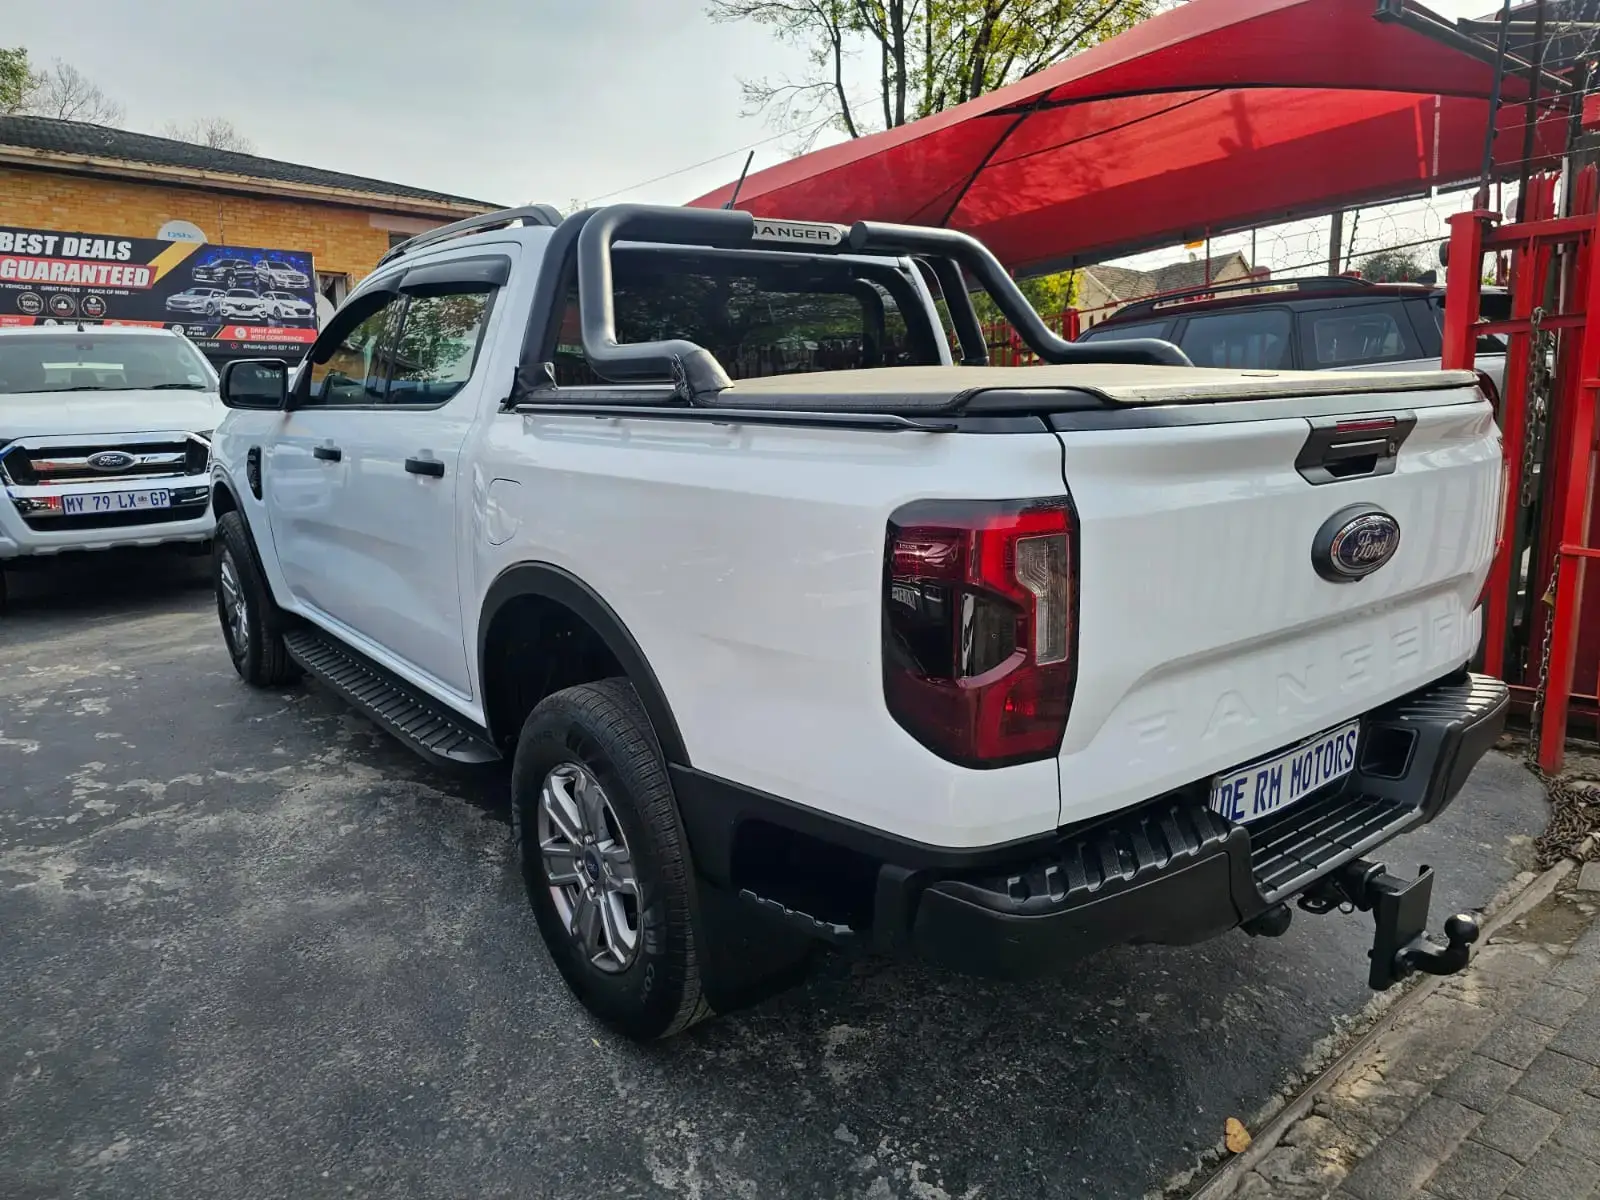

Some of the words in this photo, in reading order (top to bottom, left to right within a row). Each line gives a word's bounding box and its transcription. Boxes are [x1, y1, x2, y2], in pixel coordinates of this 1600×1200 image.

[0, 232, 59, 255] BEST
[61, 237, 132, 260] DEALS
[0, 259, 150, 287] GUARANTEED
[99, 455, 123, 466] Ford
[66, 496, 84, 513] MY
[93, 495, 110, 511] 79
[119, 493, 137, 508] LX
[150, 488, 168, 506] GP
[1352, 528, 1390, 562] Ford
[1253, 764, 1283, 814] RM
[1290, 730, 1356, 798] MOTORS
